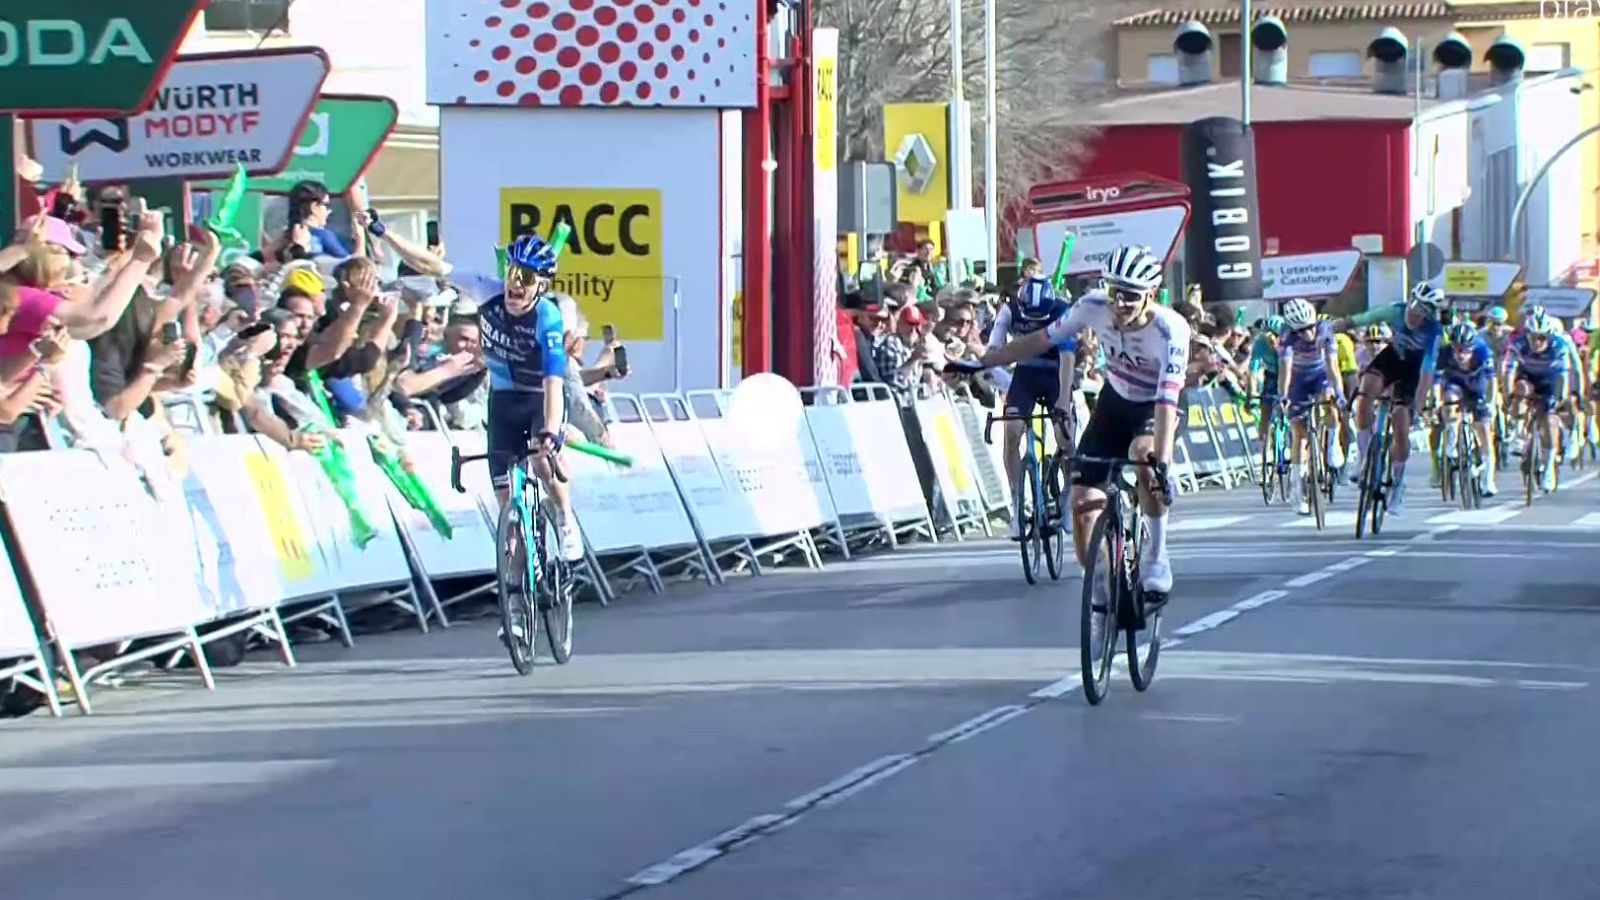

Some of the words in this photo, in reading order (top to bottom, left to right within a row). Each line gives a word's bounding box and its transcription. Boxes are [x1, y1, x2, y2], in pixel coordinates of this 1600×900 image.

[145, 111, 259, 138] MODYF
[145, 148, 261, 168] WORKWEAR
[1086, 186, 1120, 203] iryo
[1207, 159, 1253, 280] GOBIK
[1280, 264, 1327, 275] Loteries
[1280, 275, 1339, 287] Catalunya
